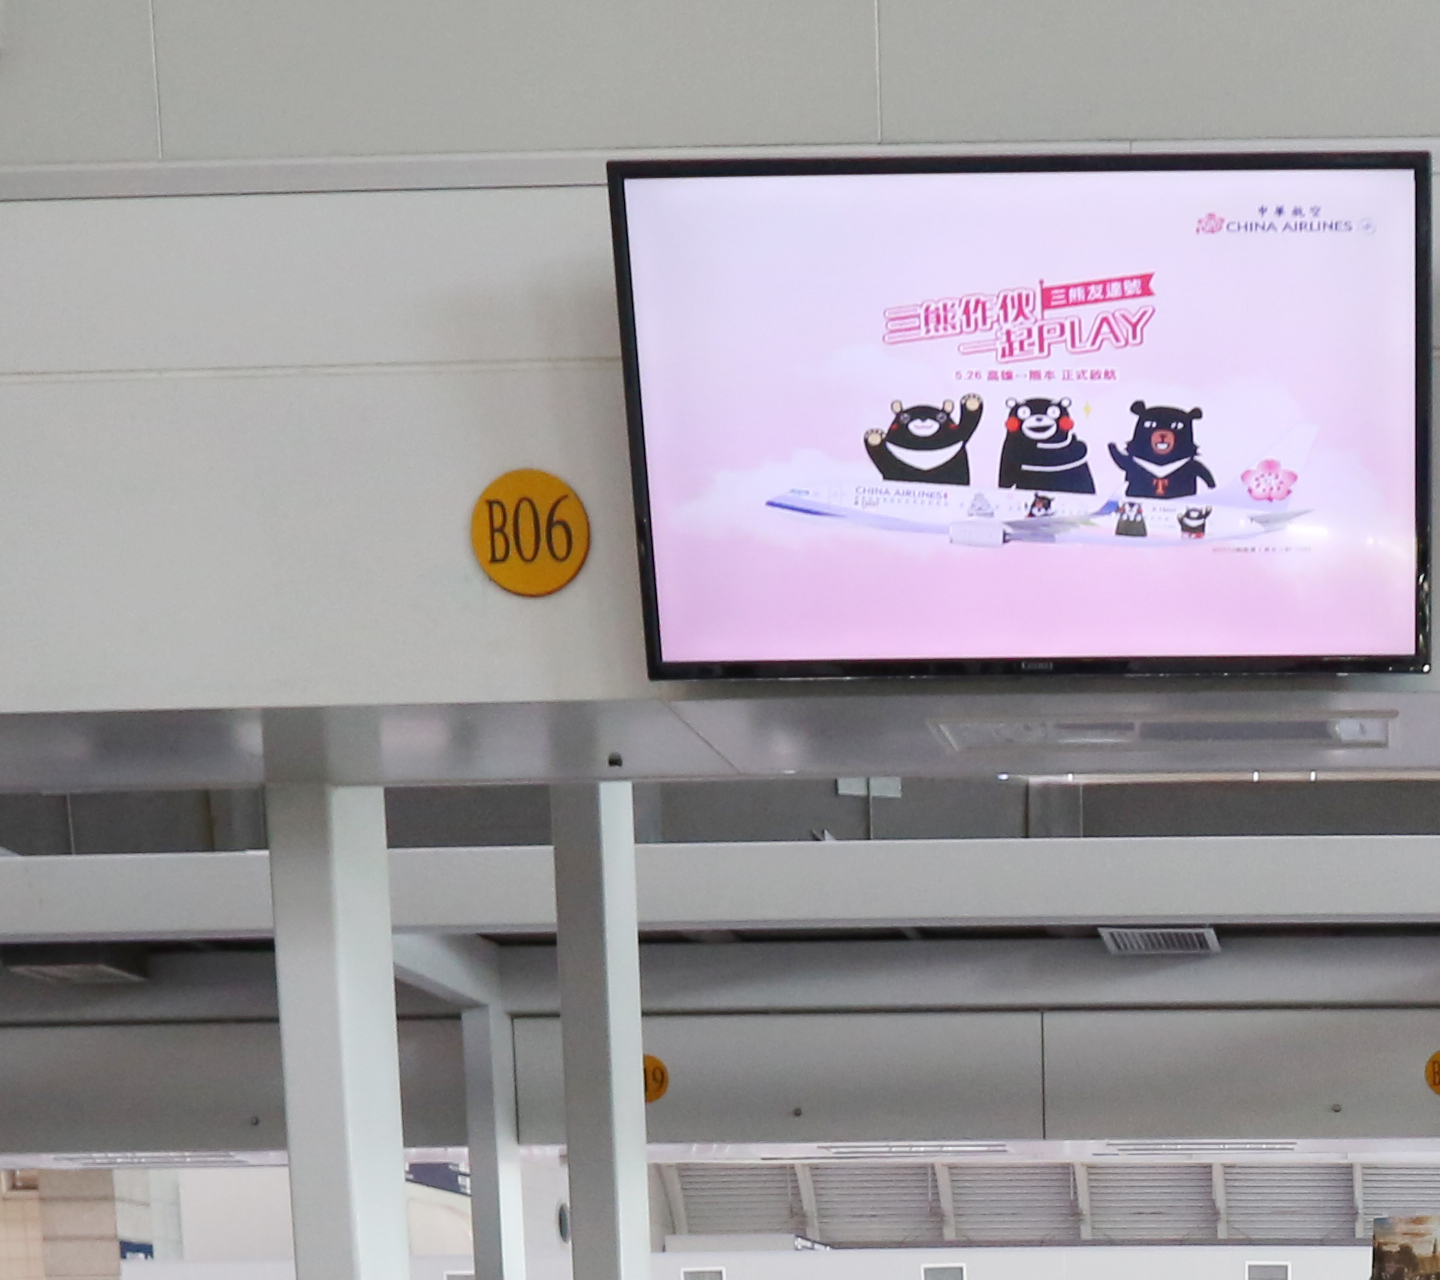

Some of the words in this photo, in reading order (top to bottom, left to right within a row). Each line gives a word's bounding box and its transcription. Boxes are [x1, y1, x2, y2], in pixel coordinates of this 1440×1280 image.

[1226, 220, 1278, 232] CHINA
[1281, 220, 1353, 232] AIRLINES
[485, 494, 574, 565] B06
[643, 1066, 665, 1093] 19
